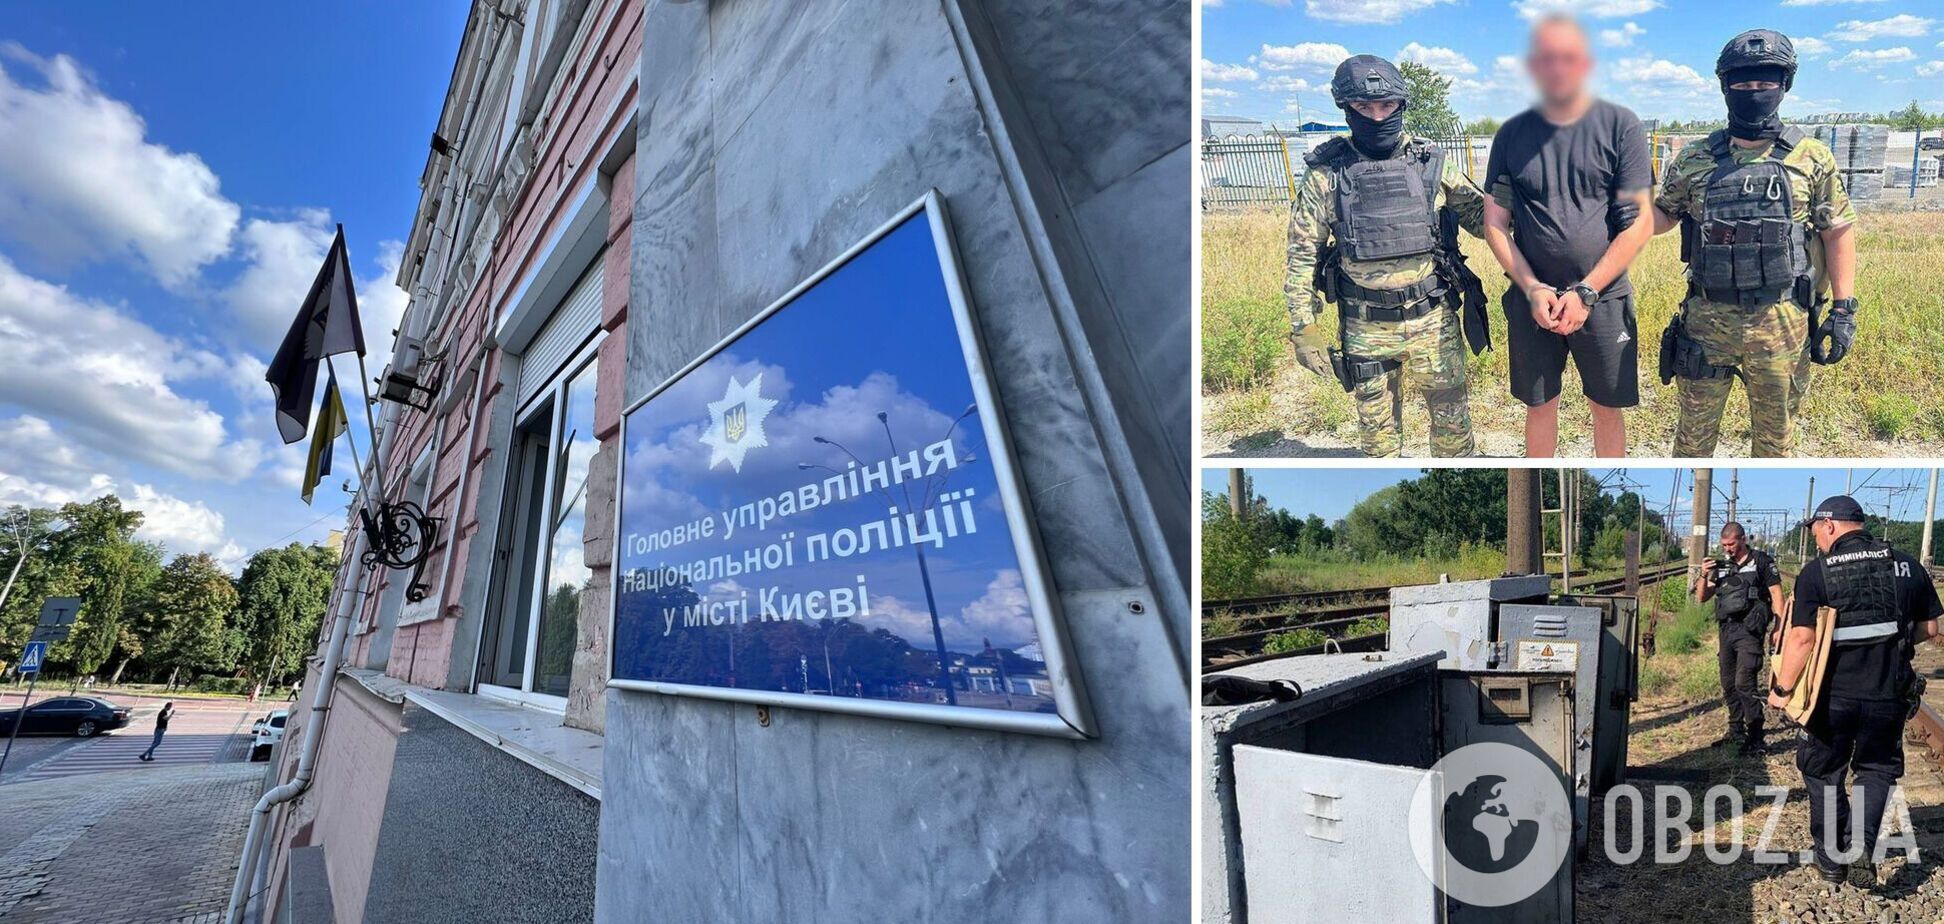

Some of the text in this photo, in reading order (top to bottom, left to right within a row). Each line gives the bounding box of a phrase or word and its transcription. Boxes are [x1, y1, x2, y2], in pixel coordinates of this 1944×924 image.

[627, 438, 958, 558] Головне управління
[623, 487, 978, 594] Національної поліції
[1826, 549, 1888, 565] КРИМІНАЛІСТ
[663, 575, 870, 637] у місті Києві
